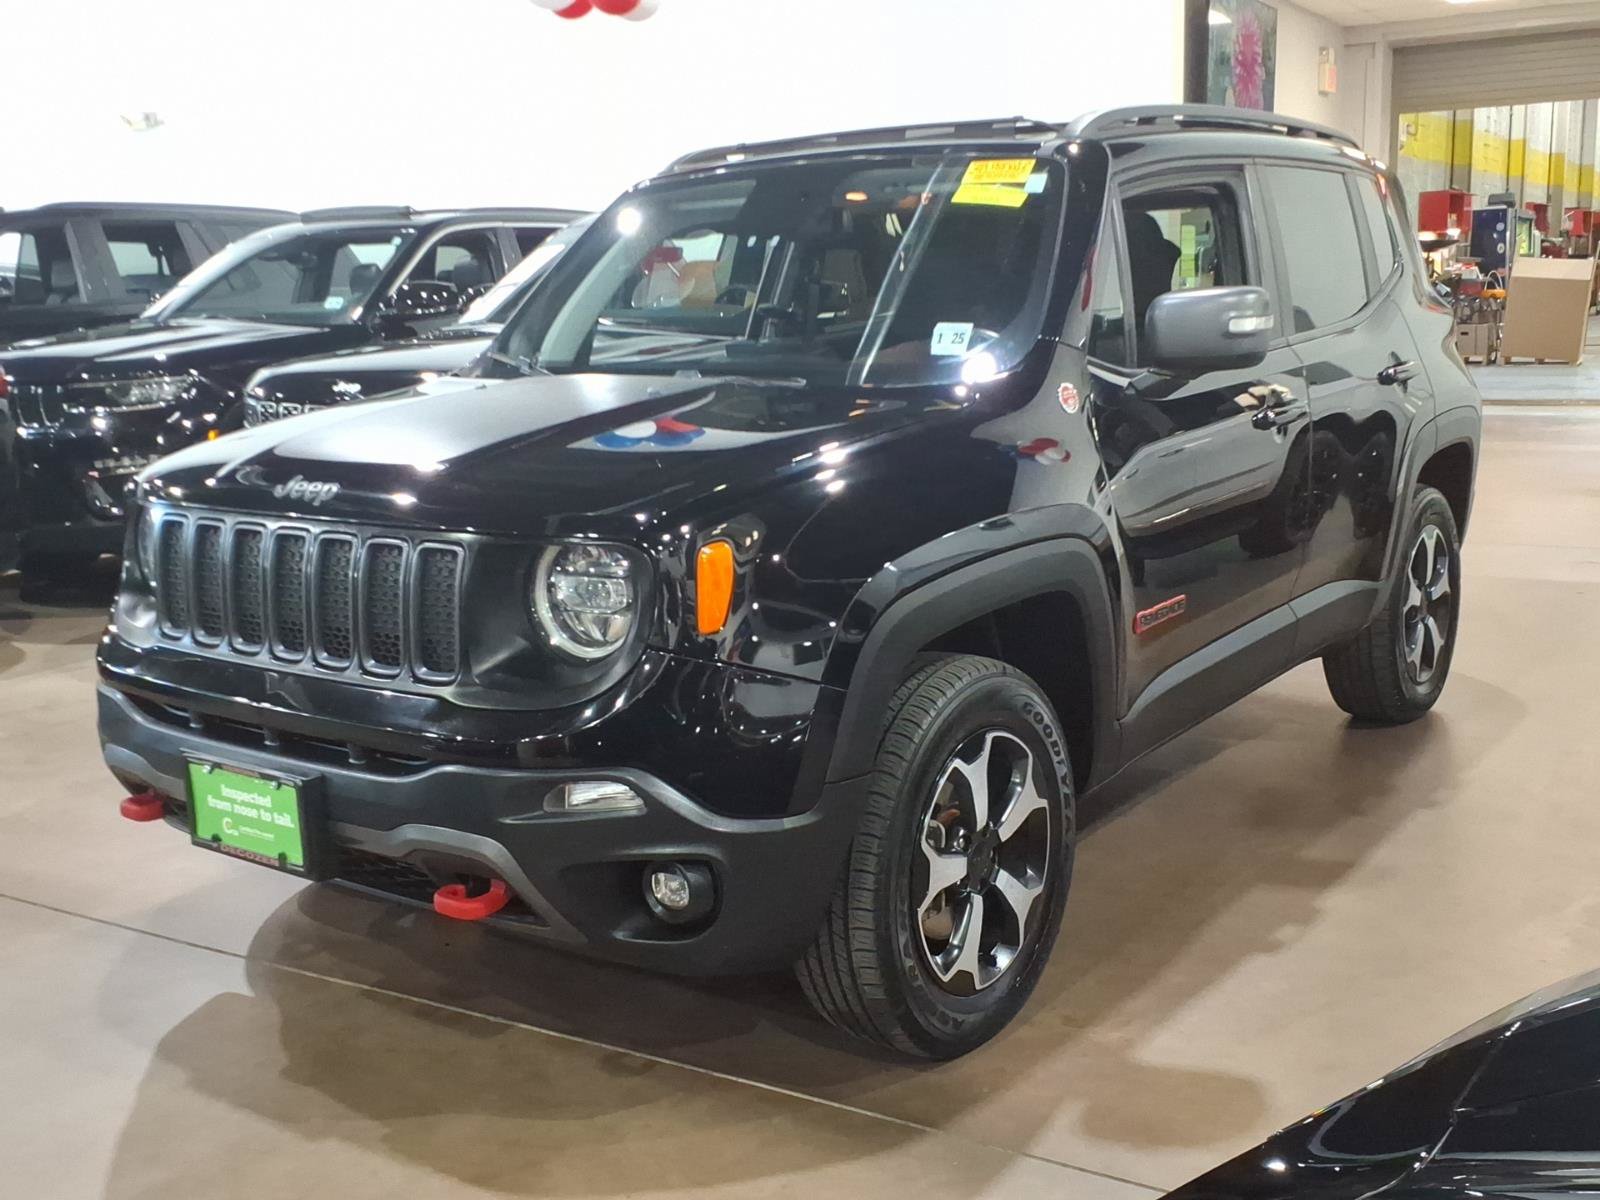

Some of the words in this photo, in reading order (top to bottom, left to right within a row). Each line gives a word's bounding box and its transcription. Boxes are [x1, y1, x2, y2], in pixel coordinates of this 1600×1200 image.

[951, 332, 966, 344] 25
[272, 474, 340, 506] Jeep
[220, 784, 272, 807] Inspected
[207, 795, 232, 812] from
[233, 804, 259, 818] nose
[260, 808, 272, 822] to
[273, 812, 294, 828] tail.
